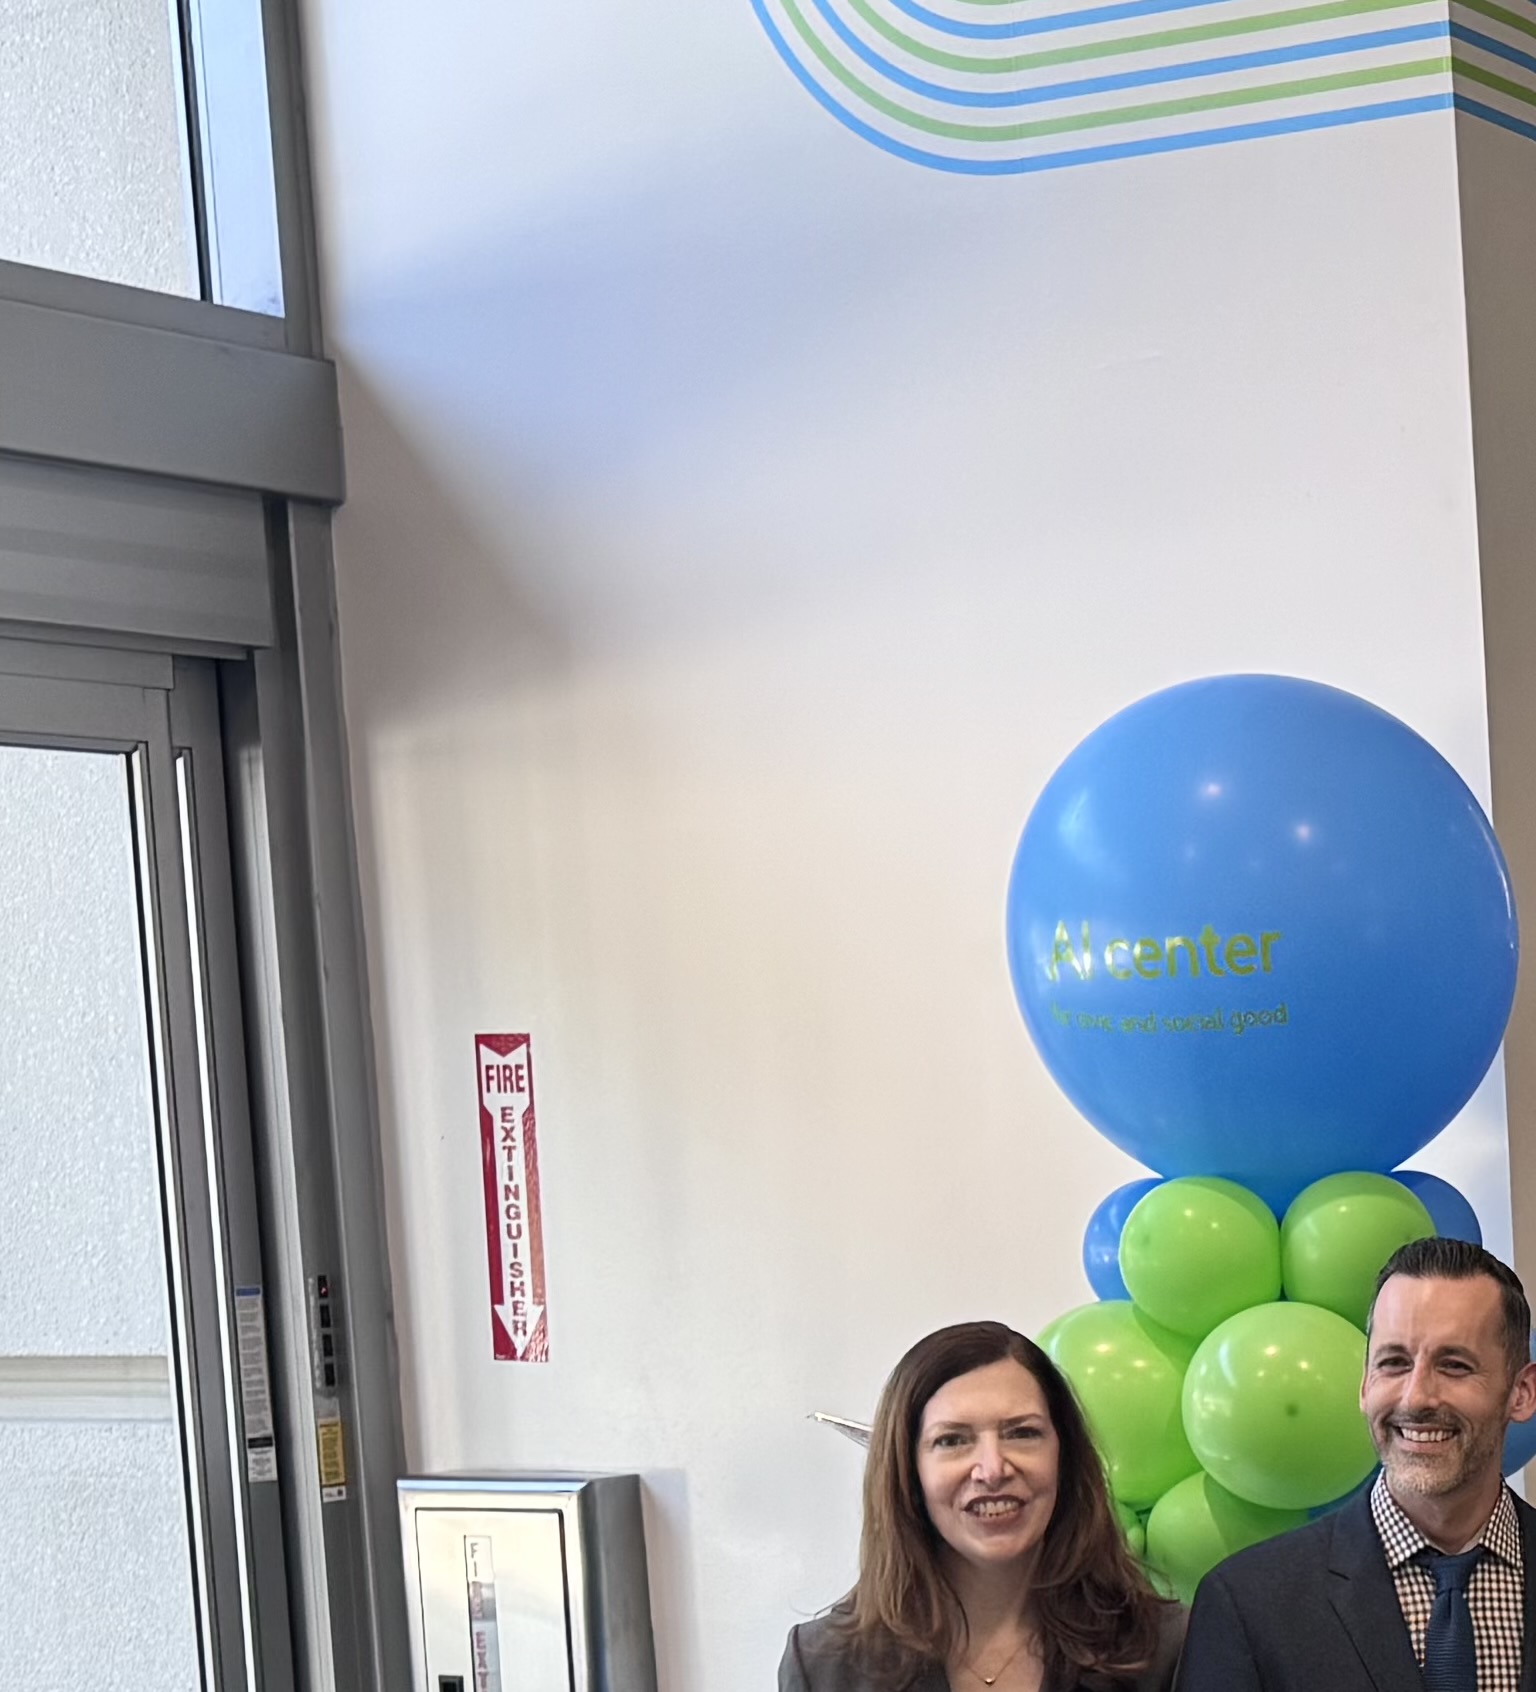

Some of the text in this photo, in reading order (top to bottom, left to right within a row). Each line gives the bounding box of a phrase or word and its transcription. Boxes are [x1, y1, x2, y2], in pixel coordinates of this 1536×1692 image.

[1046, 919, 1283, 982] AI center
[1230, 1002, 1289, 1037] good
[485, 1063, 526, 1094] FIRE
[499, 1106, 528, 1338] EXTINGUISHER
